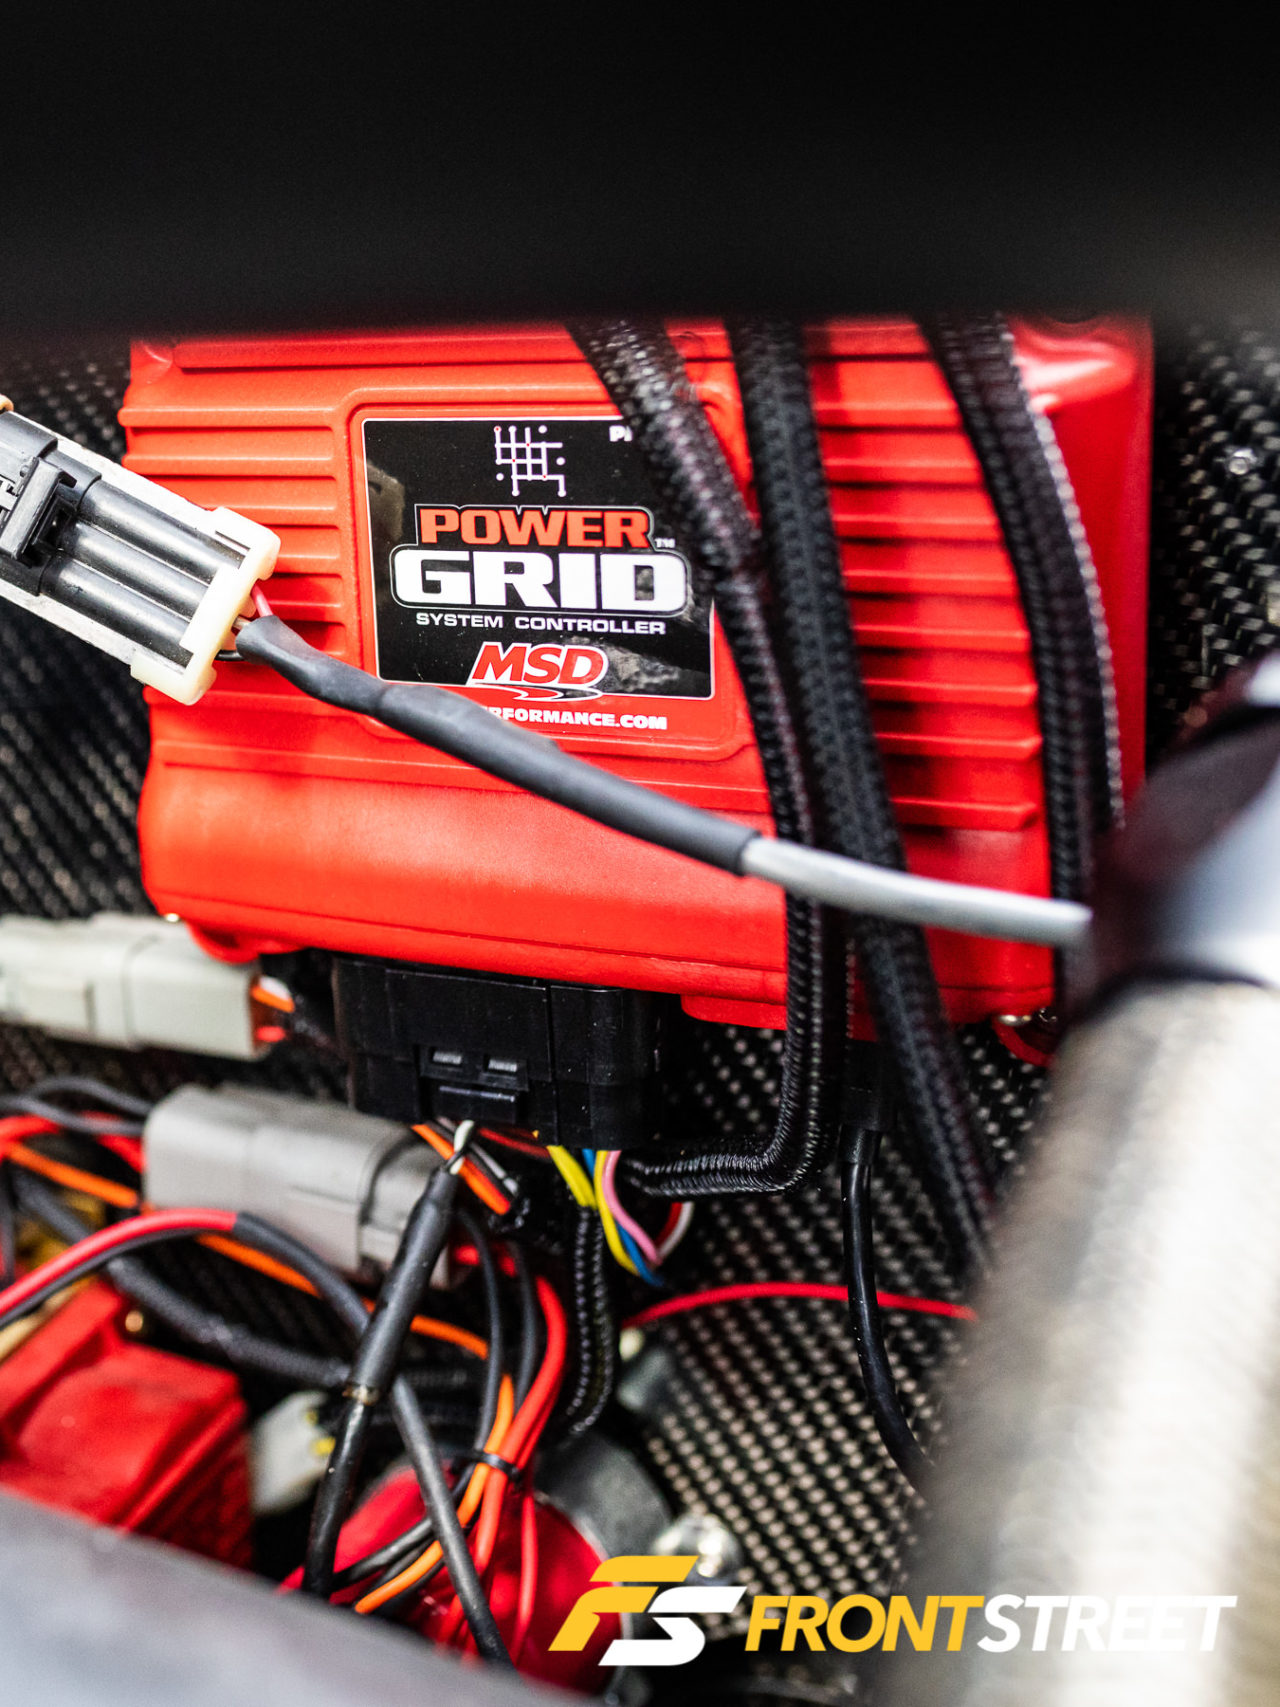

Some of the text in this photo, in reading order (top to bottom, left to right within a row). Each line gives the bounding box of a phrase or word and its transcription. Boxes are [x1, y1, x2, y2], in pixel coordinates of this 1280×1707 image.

[420, 507, 651, 547] POWER
[394, 549, 687, 612] GRID
[416, 613, 666, 635] SYSTEM CONTROLLER
[469, 643, 607, 686] MSD
